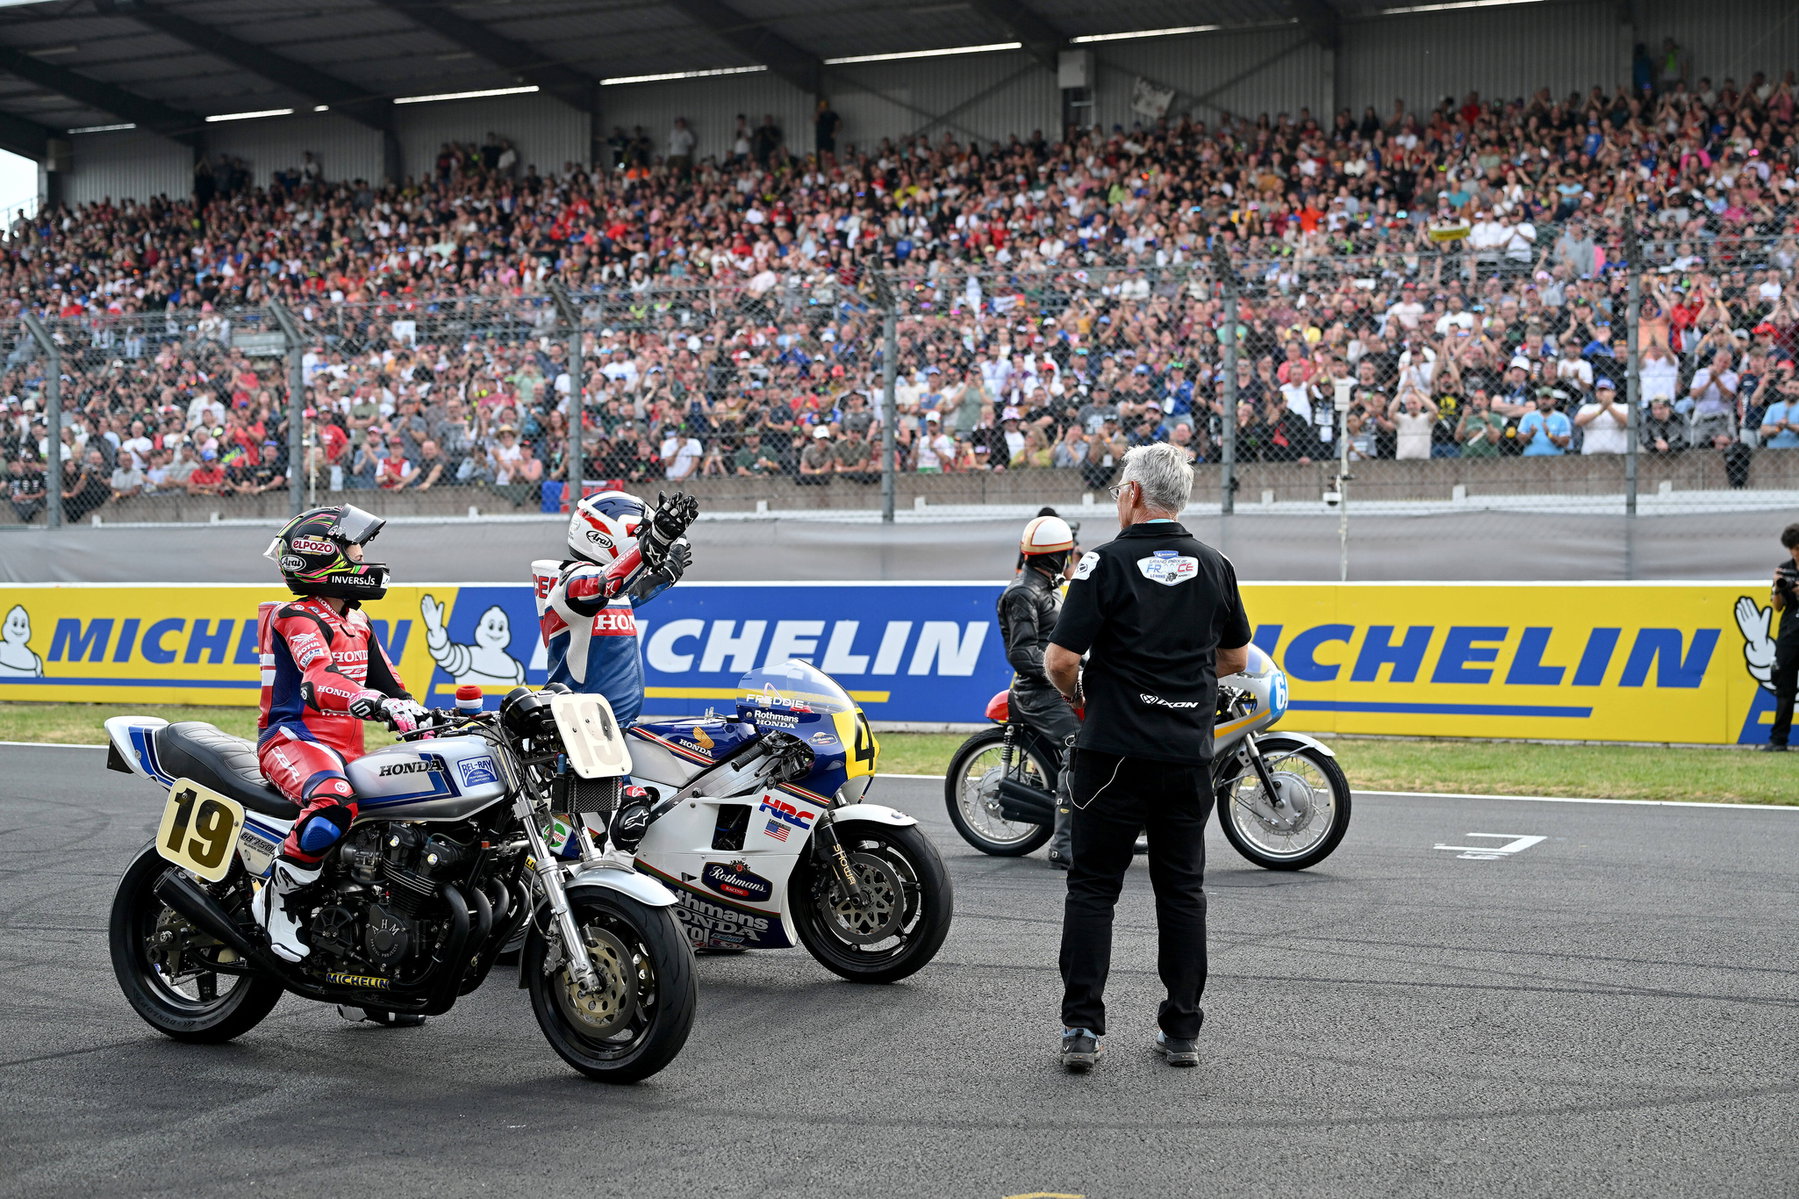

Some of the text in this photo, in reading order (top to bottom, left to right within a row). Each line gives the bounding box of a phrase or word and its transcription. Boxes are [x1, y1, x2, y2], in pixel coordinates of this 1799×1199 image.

[587, 533, 612, 548] Arai
[282, 556, 302, 568] Arai
[1146, 563, 1194, 573] FRCE
[331, 649, 369, 663] HOND
[529, 619, 990, 677] CHELIN
[1252, 623, 1722, 689] ICHELIN
[745, 693, 805, 709] FREDDIE
[754, 709, 799, 723] Rothmans
[755, 719, 796, 729] HONDA
[560, 701, 624, 767] 19
[854, 712, 875, 771] 4
[679, 737, 714, 759] HONDA
[378, 758, 445, 777] HONDA
[461, 759, 493, 778] BEL-RAY
[758, 793, 815, 831] HRC
[166, 787, 235, 869] 19
[832, 842, 857, 885] SHOWA
[708, 864, 767, 894] Rothmans
[674, 888, 769, 931] thmans
[371, 918, 400, 936] AHM
[672, 906, 761, 942] ONDA
[326, 972, 390, 990] MICHELIN
